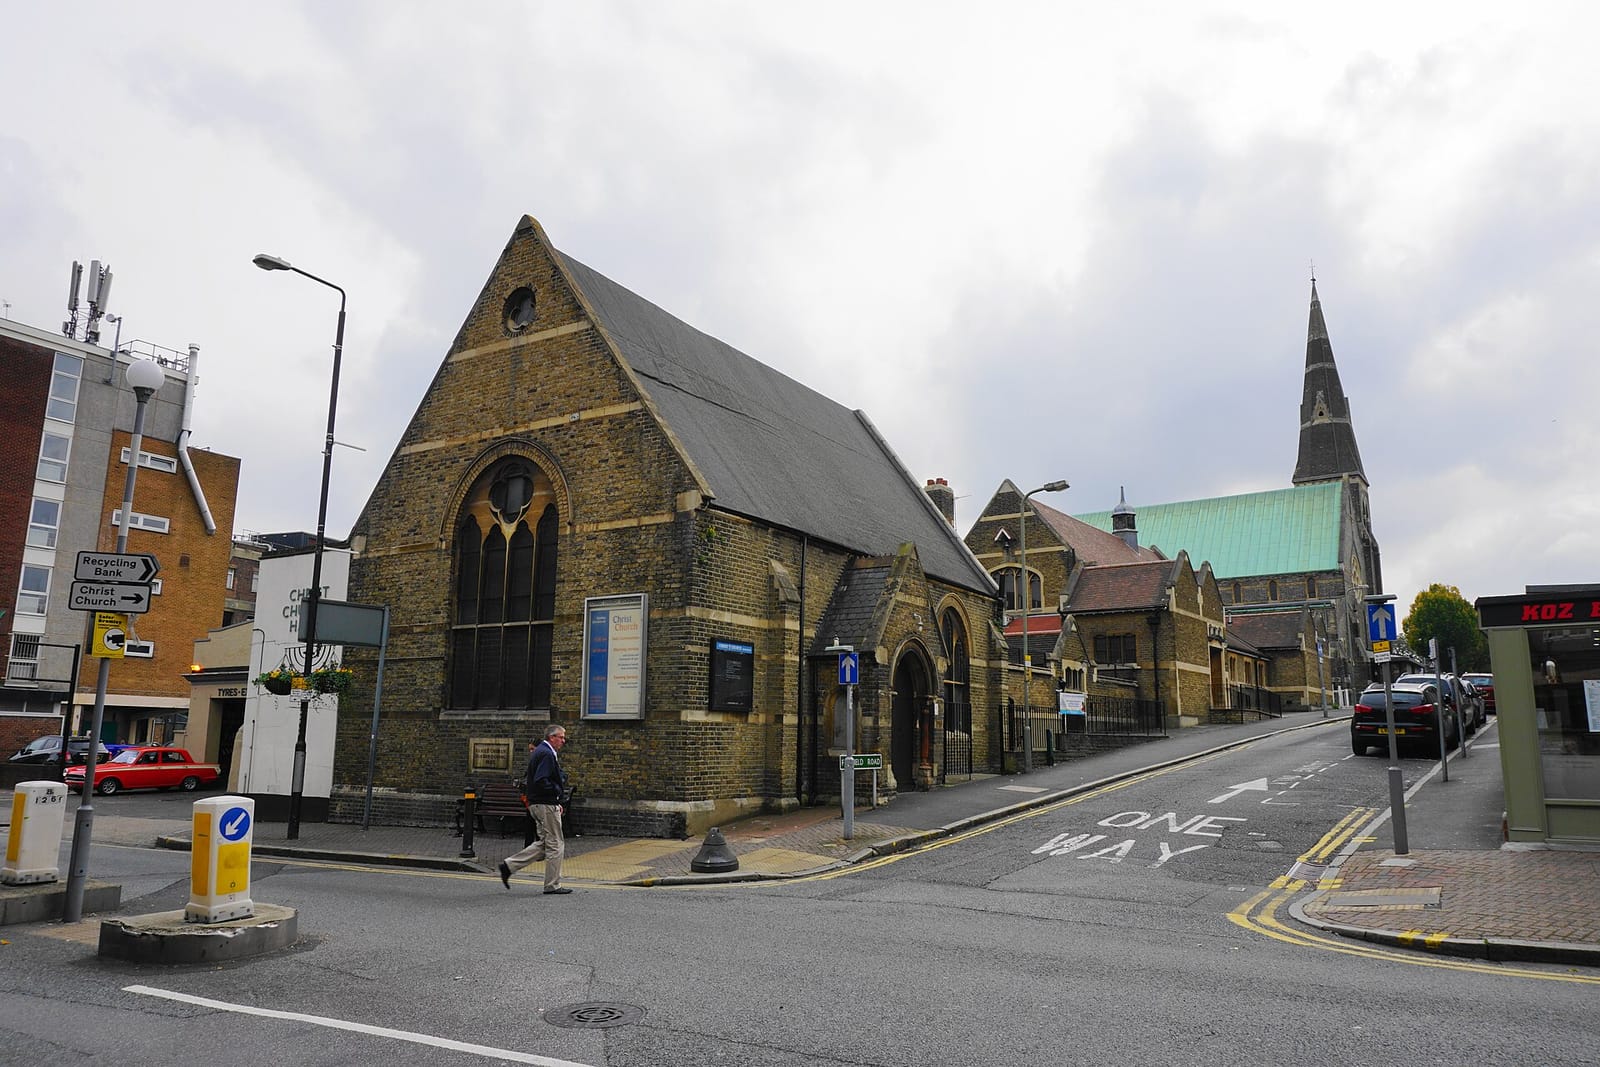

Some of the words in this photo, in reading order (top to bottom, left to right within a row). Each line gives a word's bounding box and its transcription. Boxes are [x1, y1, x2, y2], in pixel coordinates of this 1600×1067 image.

[83, 556, 137, 569] Recycling
[94, 568, 123, 577] Bank
[80, 585, 115, 596] Christ
[75, 596, 117, 606] Church
[1521, 602, 1575, 621] KOZ
[612, 615, 632, 624] Christ
[614, 623, 639, 632] Church
[867, 757, 881, 766] ROAD
[1097, 811, 1248, 837] ONE
[1030, 832, 1209, 869] WAY
